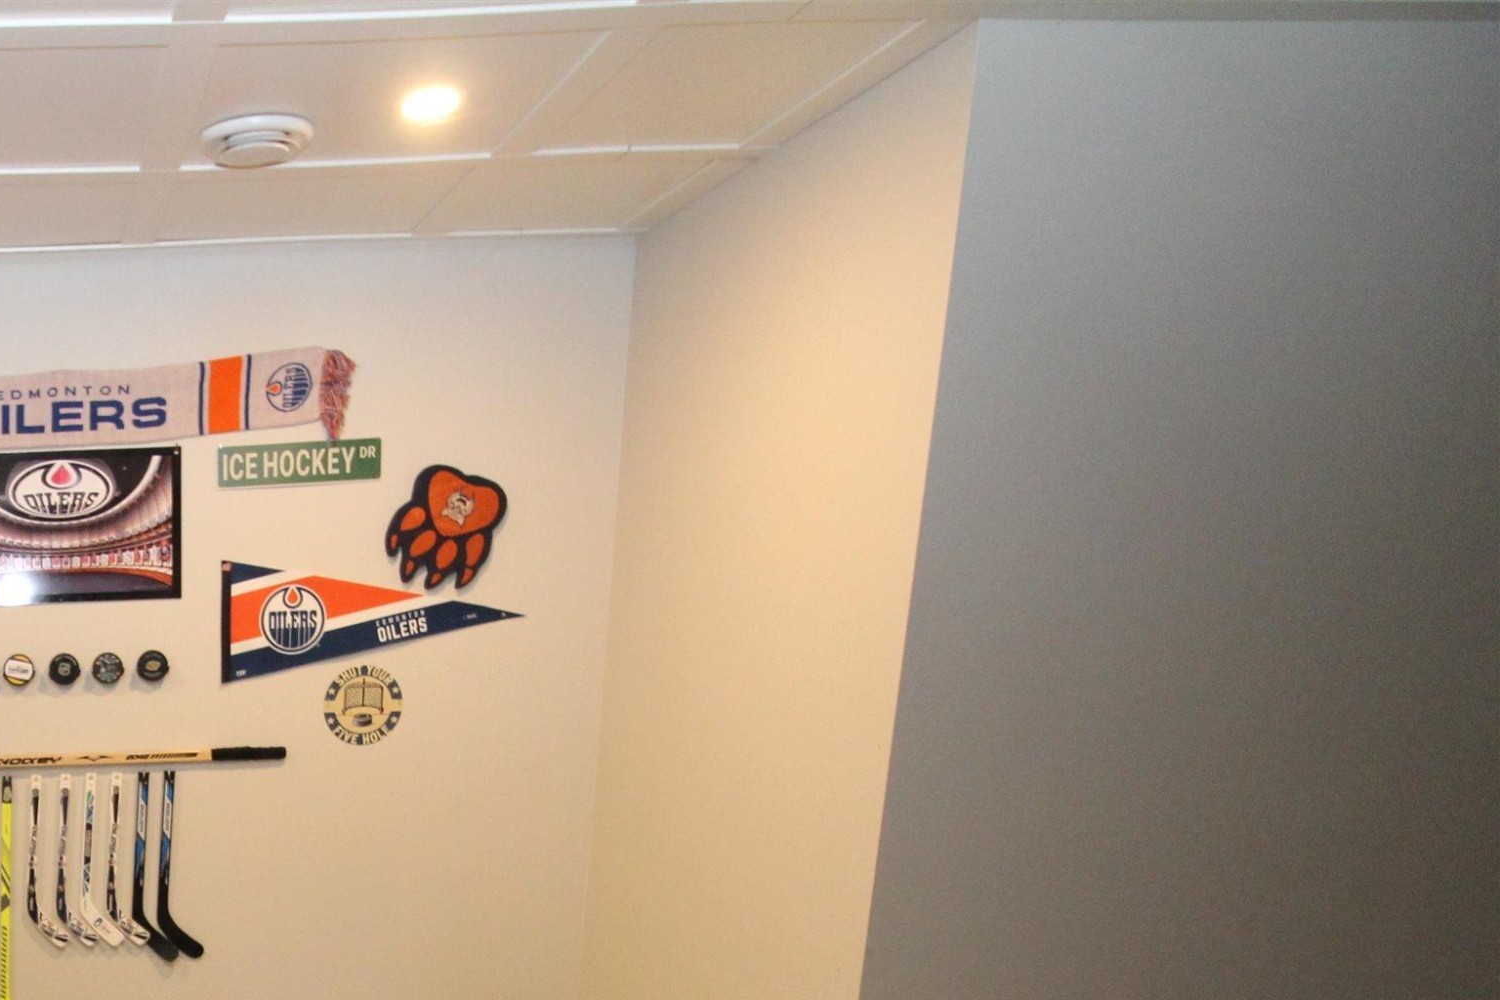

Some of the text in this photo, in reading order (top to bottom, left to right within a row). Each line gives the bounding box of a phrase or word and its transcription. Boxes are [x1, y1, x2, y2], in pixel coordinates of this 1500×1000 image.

[222, 445, 376, 481] ICE HOCKEY DR
[23, 491, 100, 514] OILERS
[268, 609, 318, 630] OILERS
[376, 610, 426, 627] EDMONTON
[377, 617, 428, 643] OILERS
[0, 926, 8, 1000] WARRIOR
